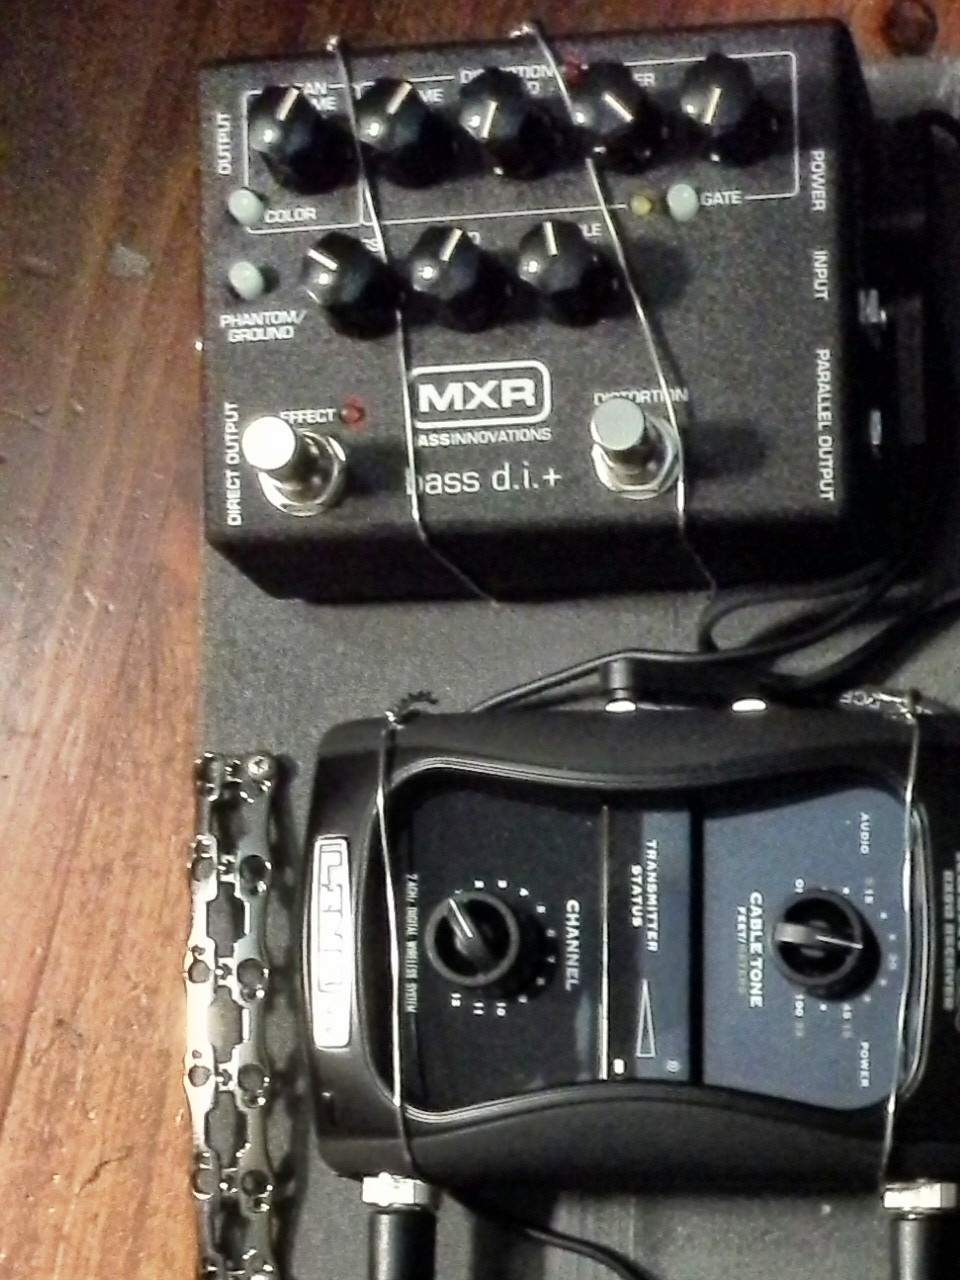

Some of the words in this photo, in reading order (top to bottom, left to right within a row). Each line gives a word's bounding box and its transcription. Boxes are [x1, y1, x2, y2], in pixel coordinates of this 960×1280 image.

[217, 112, 232, 176] OUTPUT
[702, 190, 742, 207] GATE
[810, 149, 825, 212] POWER
[264, 206, 318, 225] COLOR
[814, 249, 829, 301] INPUT
[227, 324, 295, 343] GROUND
[418, 377, 538, 412] MXR
[814, 348, 832, 417] PARALLEL
[225, 402, 240, 452] OUTPUT
[416, 427, 553, 448] ASSINNOVATIONS
[816, 419, 833, 502] OUTPUT
[225, 455, 241, 526] DIRECT
[859, 812, 870, 855] AUDIO
[630, 863, 644, 928] STATUS
[645, 839, 659, 953] TRANSMITTER
[565, 899, 582, 992] CHANNEL
[748, 891, 764, 954] CABLE
[748, 956, 764, 1009] TONE
[859, 1040, 870, 1088] POWER
